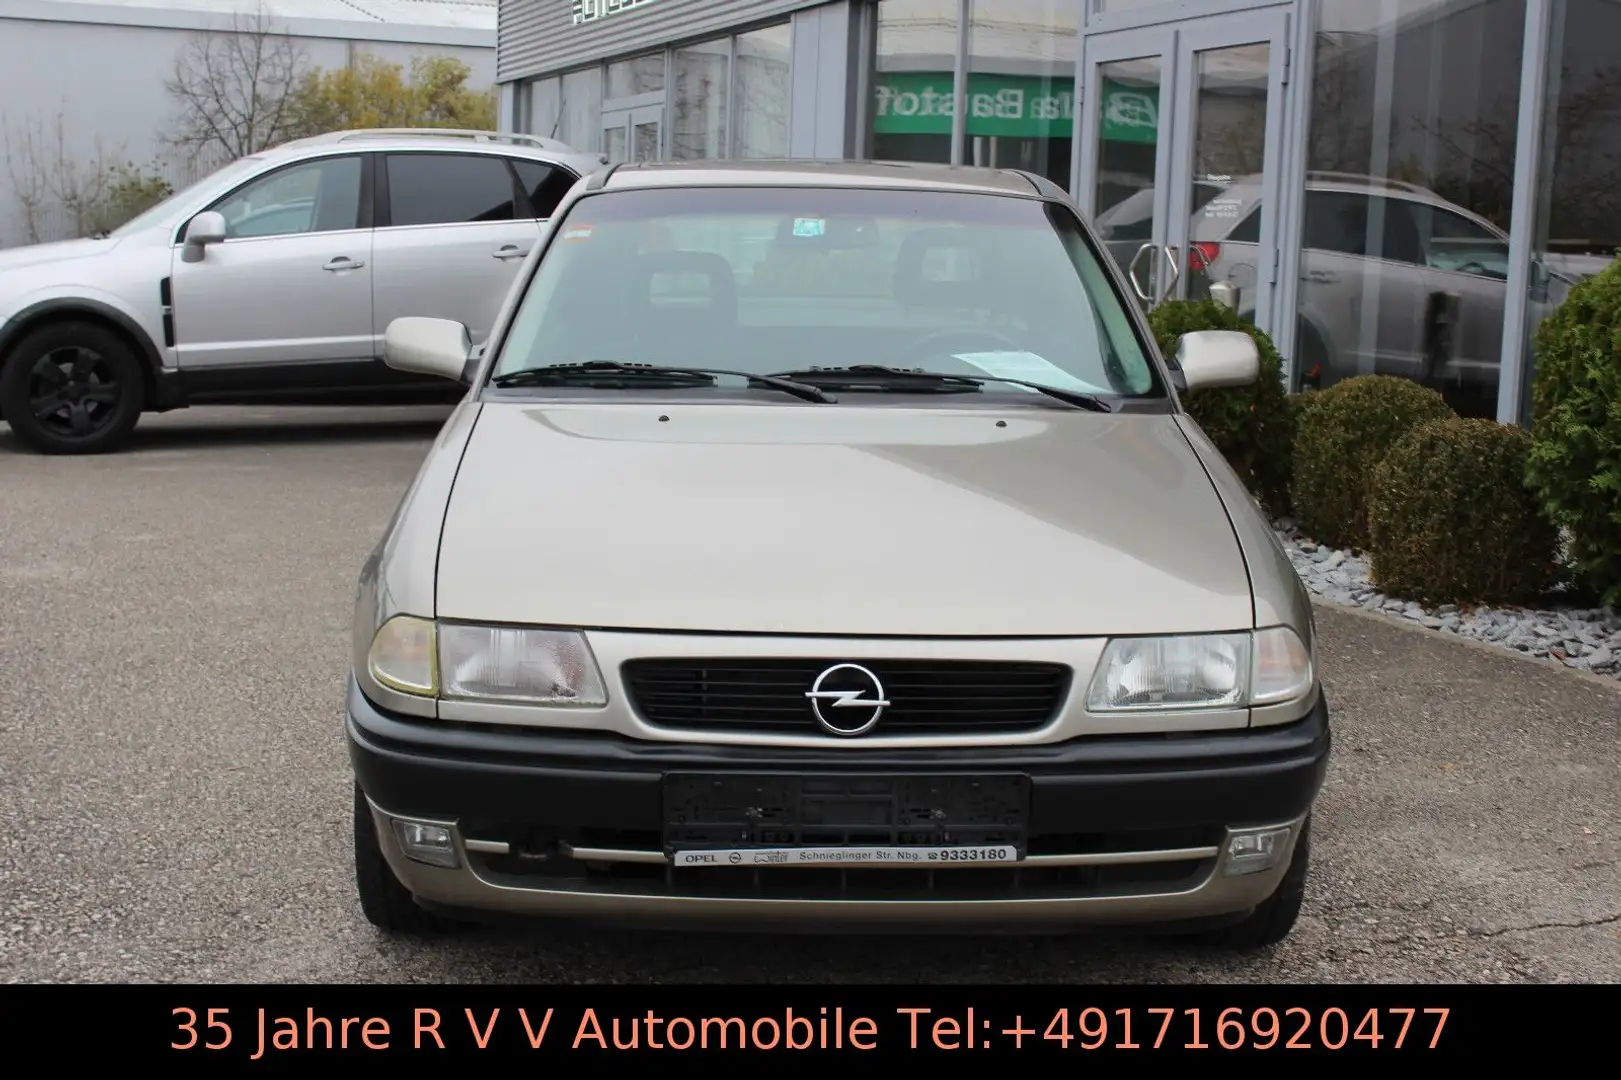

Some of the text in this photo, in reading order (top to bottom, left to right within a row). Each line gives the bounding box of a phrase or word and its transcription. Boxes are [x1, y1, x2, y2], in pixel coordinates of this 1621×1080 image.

[685, 854, 718, 863] OPEL
[799, 851, 872, 861] Schnieglinger
[876, 850, 894, 860] Str.
[897, 851, 922, 861] Nbg.
[940, 849, 1007, 861] 9333180
